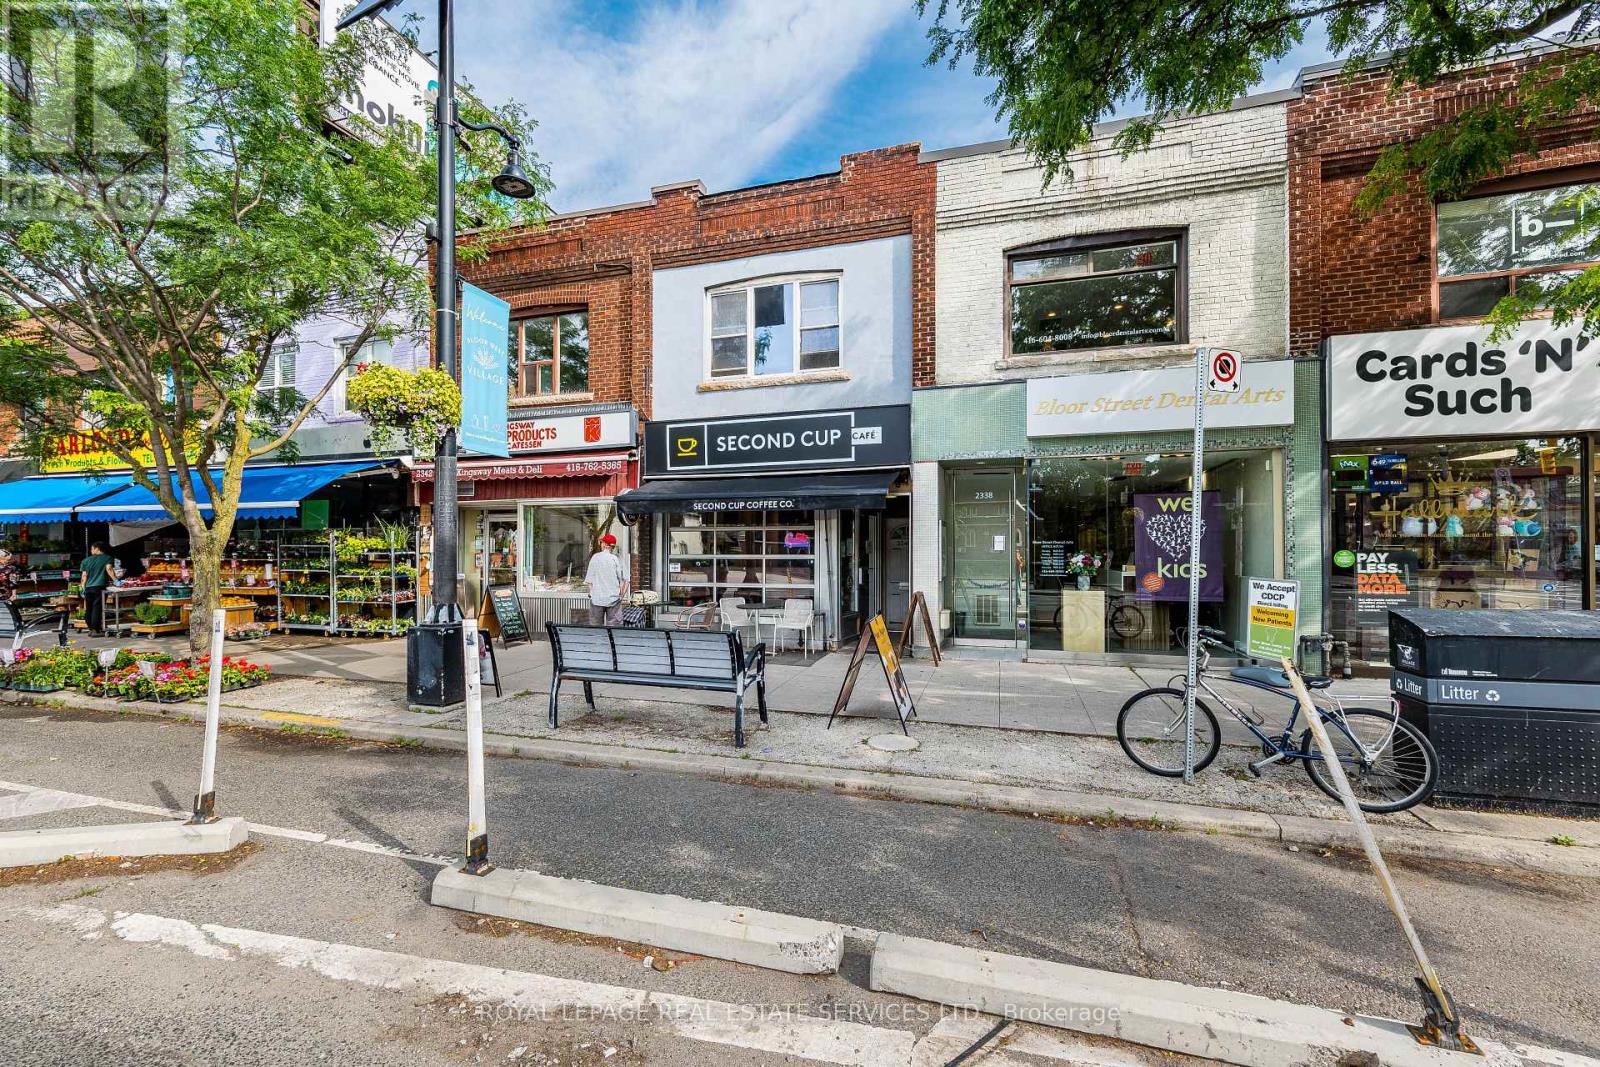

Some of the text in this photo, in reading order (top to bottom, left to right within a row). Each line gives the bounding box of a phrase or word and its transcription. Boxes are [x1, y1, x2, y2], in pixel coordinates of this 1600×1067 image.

[1355, 341, 1507, 383] Cards
[467, 364, 505, 385] VILLAGE
[1032, 398, 1089, 416] Bloor
[1090, 395, 1154, 413] Street
[1235, 386, 1287, 405] Arts
[1403, 377, 1532, 417] Such
[716, 429, 841, 453] SECOND CUP
[416, 468, 434, 479] 2342
[493, 465, 517, 477] Meats
[518, 466, 525, 477] &
[525, 465, 543, 478] Deli
[566, 460, 622, 475] 416-762-5365
[975, 491, 994, 500] 2338
[693, 502, 727, 511] SECOND
[728, 501, 746, 510] CUP
[746, 500, 778, 509] COFFEE
[1356, 552, 1390, 564] PAY
[1356, 563, 1403, 574] LESS.
[1357, 573, 1402, 584] DATA
[1252, 582, 1297, 594] We Accept
[1261, 592, 1286, 602] CDCP
[1256, 608, 1290, 619] Welcoming
[1253, 615, 1292, 627] New Patients
[1404, 678, 1423, 696] Litter
[1441, 684, 1480, 701] Litter
